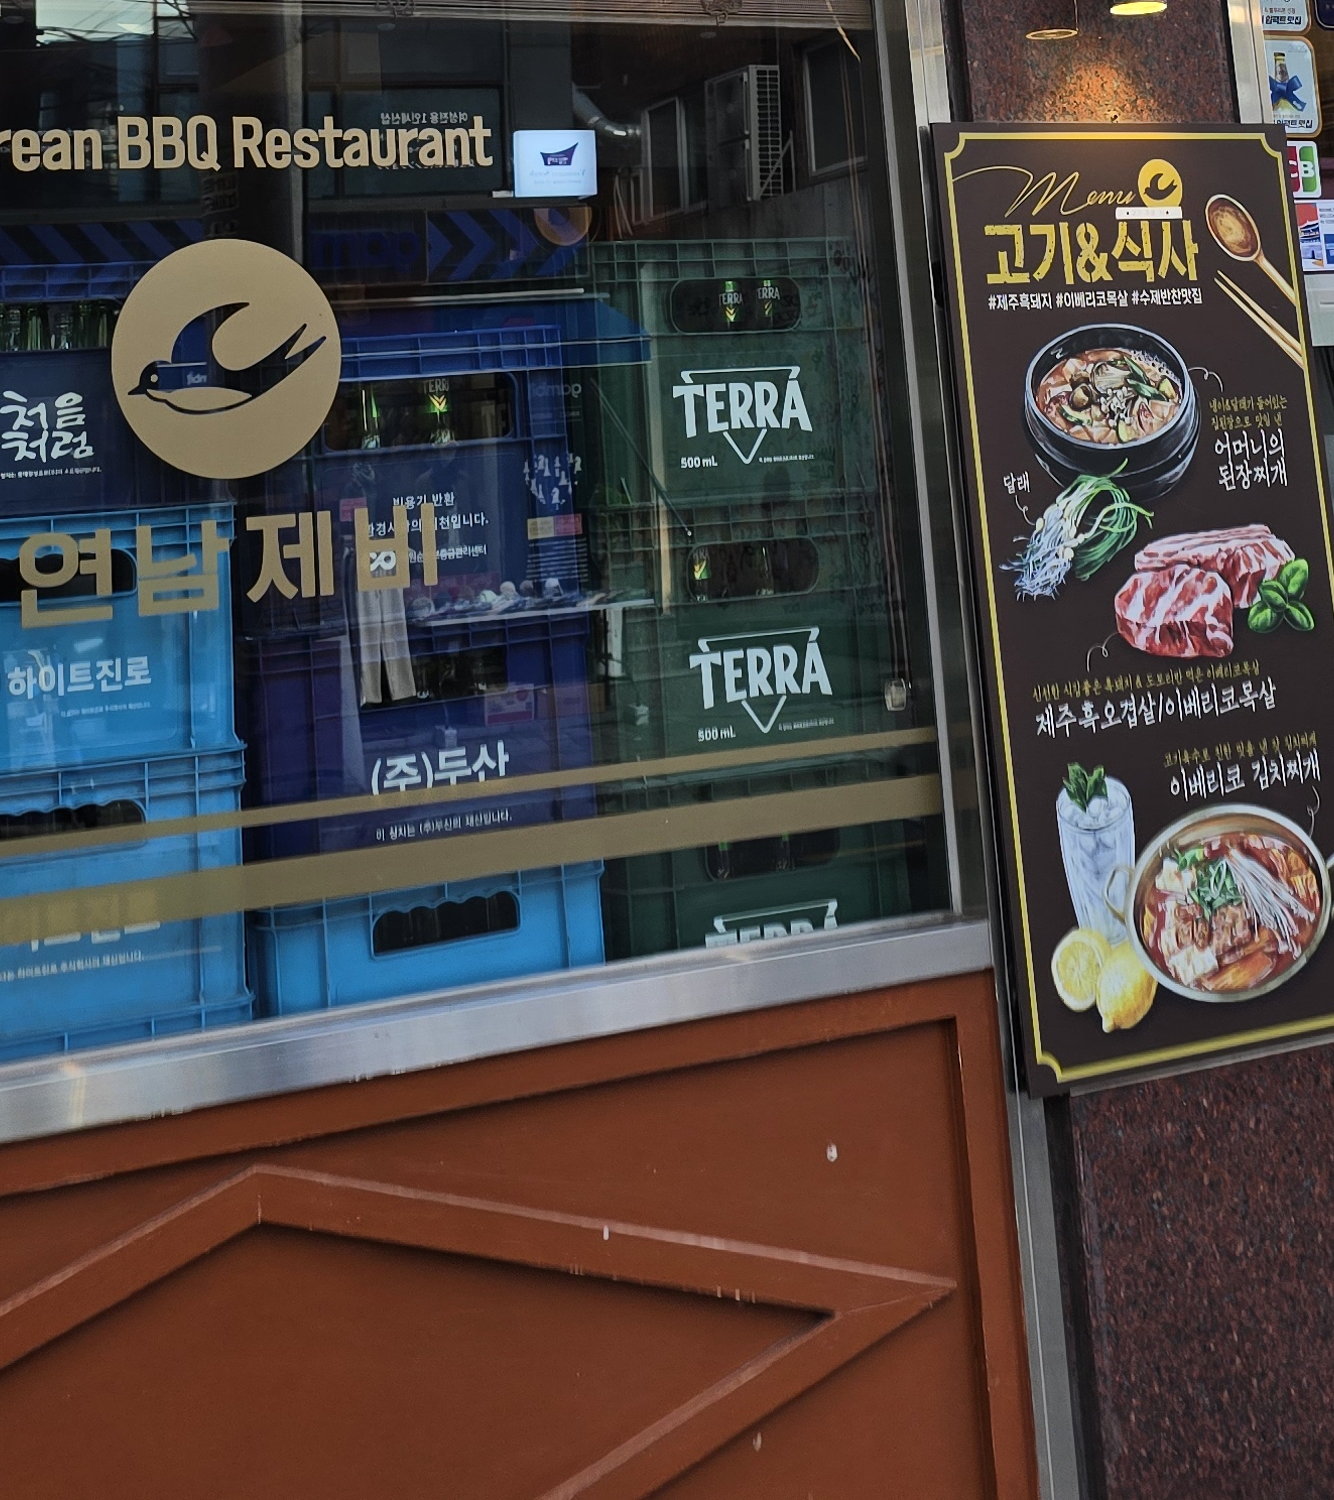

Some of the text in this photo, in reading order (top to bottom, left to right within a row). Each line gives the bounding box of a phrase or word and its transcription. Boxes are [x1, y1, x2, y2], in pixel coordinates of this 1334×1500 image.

[1286, 15, 1302, 25] 맛집
[118, 114, 222, 173] BBQ
[233, 115, 494, 169] Restaurant
[953, 164, 1137, 219] Menu
[983, 219, 1199, 285] 고기&식사
[987, 287, 1203, 312] #제주흑돼지 #이베리코목살 #수제반찬맛집
[0, 390, 86, 431] 처음
[672, 378, 813, 439] TERRA
[1, 429, 95, 463] 처럼
[680, 455, 718, 469] 500 mL
[1214, 427, 1285, 462] 어머니의
[1218, 456, 1288, 491] 된장찌개
[431, 491, 455, 507] 반환
[433, 511, 489, 531] 천입니다.
[18, 502, 439, 628] 연남제비
[6, 655, 152, 700] 하이트진로
[688, 639, 833, 710] TERRA
[371, 739, 510, 797] (주)두산
[1170, 747, 1321, 802] 이베리코 김치찌개
[376, 827, 385, 842] 이
